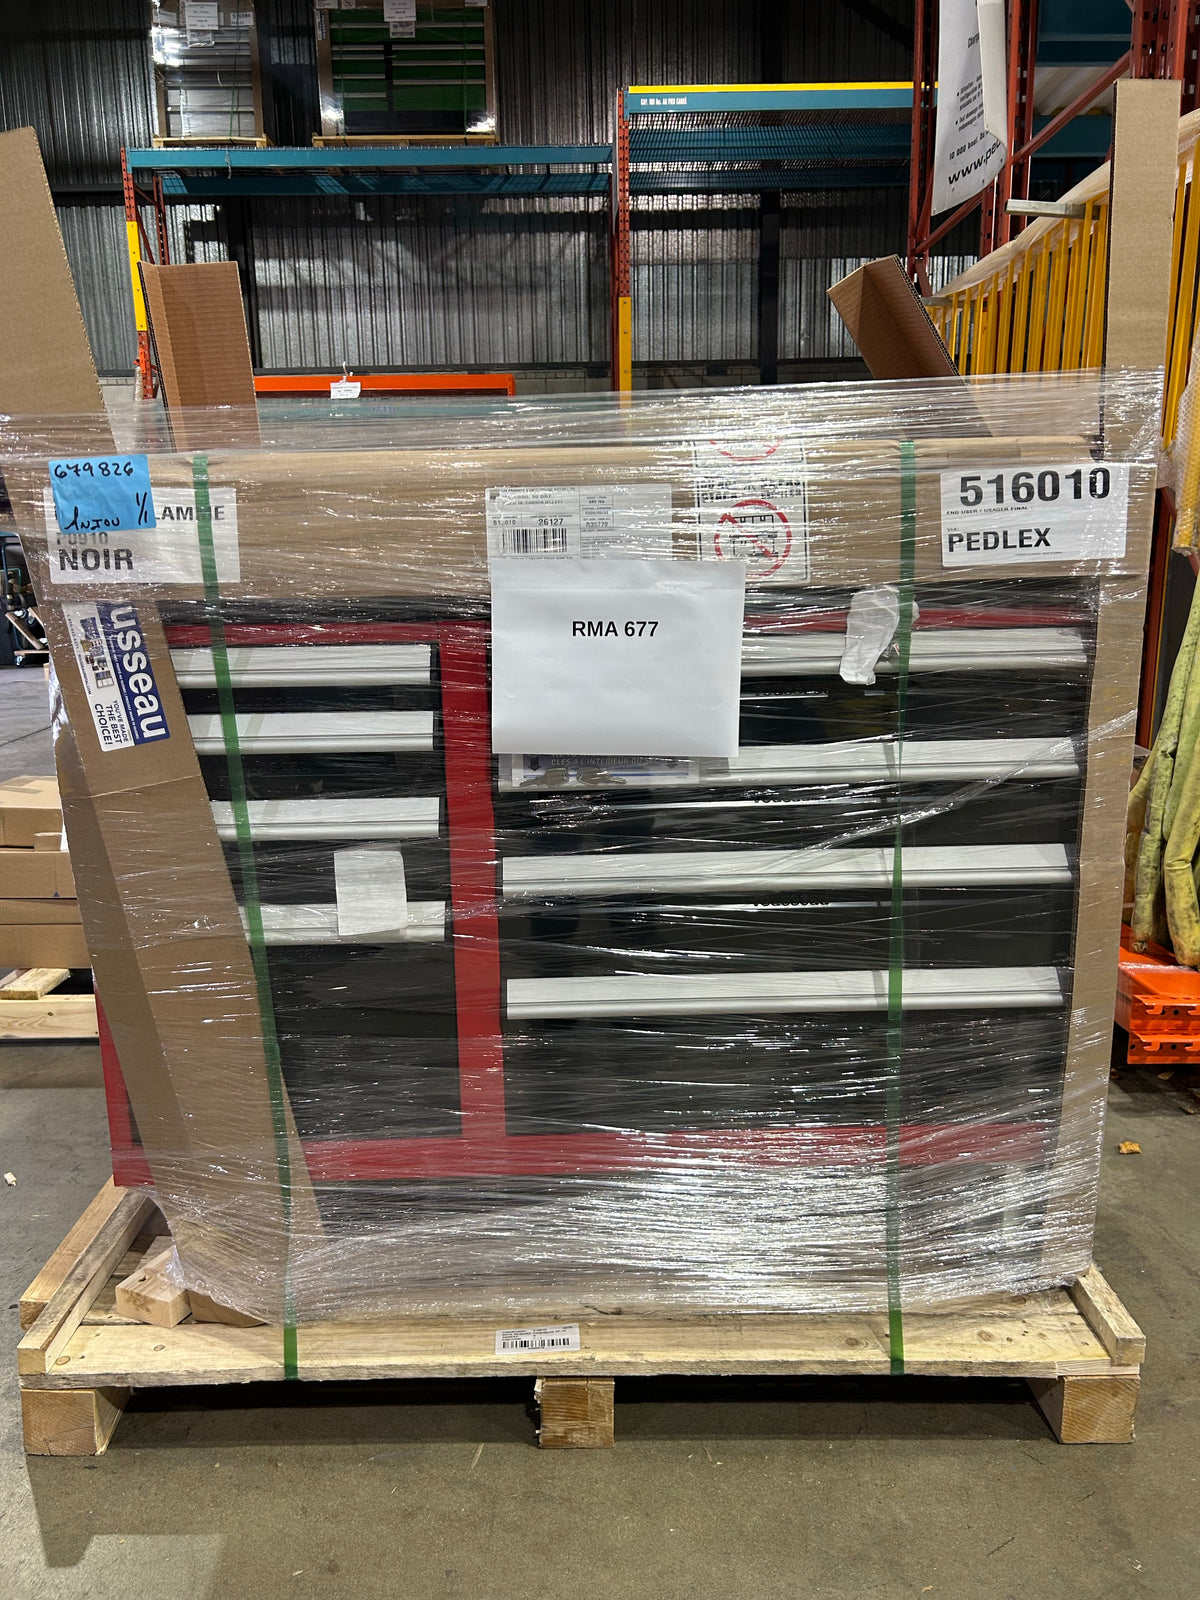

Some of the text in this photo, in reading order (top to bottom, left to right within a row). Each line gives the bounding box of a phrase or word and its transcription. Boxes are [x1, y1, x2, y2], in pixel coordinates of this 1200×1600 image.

[960, 467, 1110, 506] 516010
[948, 528, 1051, 552] PEDLEX
[59, 548, 134, 570] NOIR
[572, 621, 658, 636] RMA 677
[95, 703, 113, 745] CHOICE!
[106, 705, 122, 743] THE BEST
[120, 723, 128, 742] MADE
